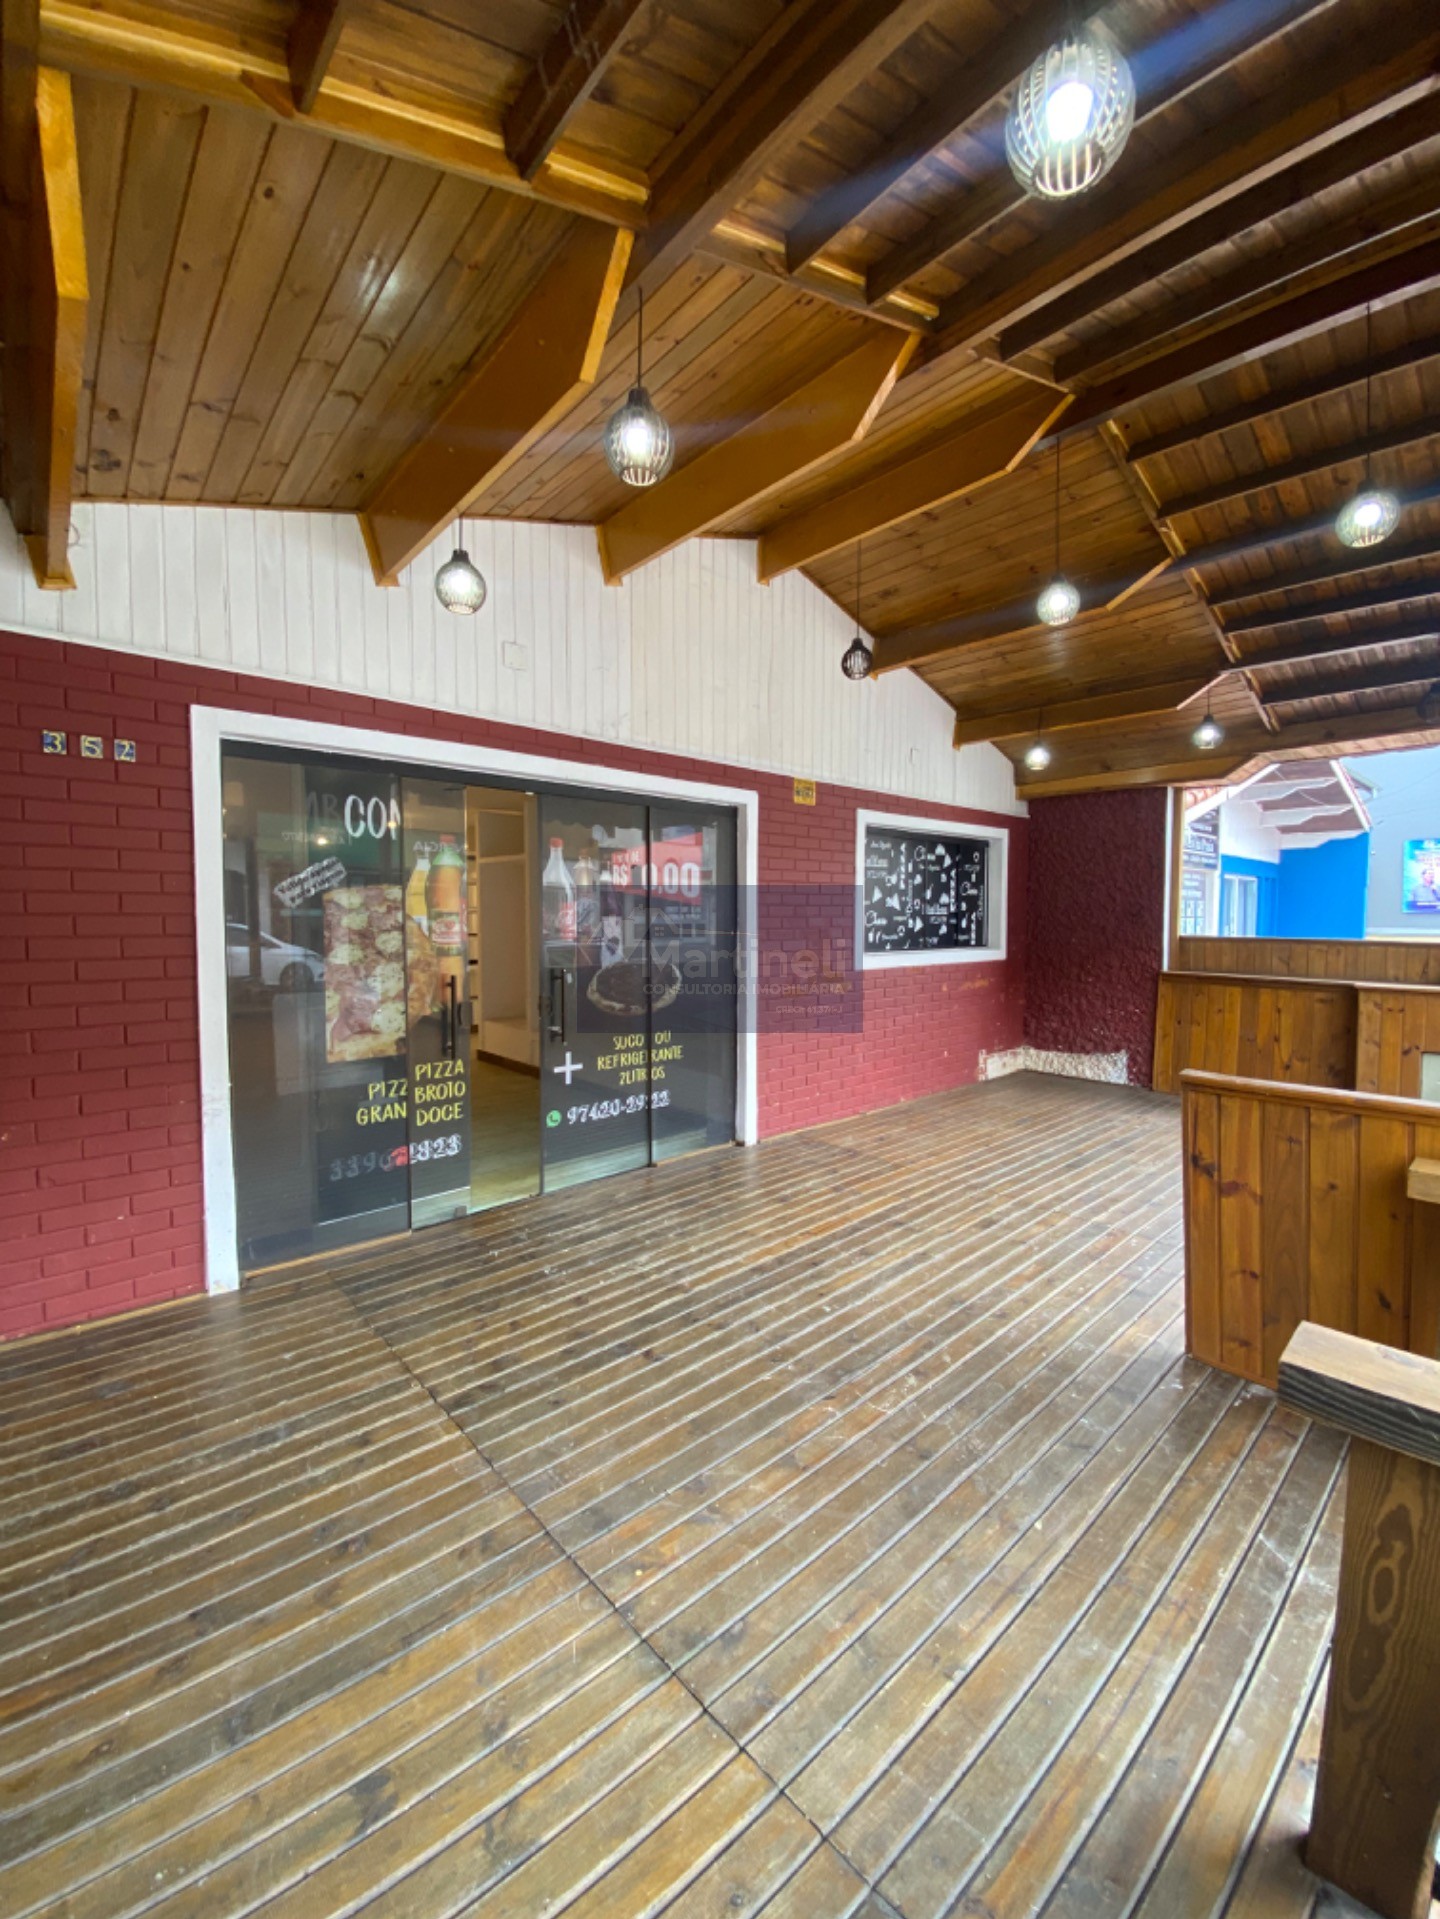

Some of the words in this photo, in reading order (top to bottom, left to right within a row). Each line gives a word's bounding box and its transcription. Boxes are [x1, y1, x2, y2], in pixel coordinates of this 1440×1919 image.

[612, 1033, 645, 1051] SUCO
[654, 1030, 672, 1045] OU
[414, 1059, 465, 1081] PIZZA
[416, 1102, 464, 1127] DOCE
